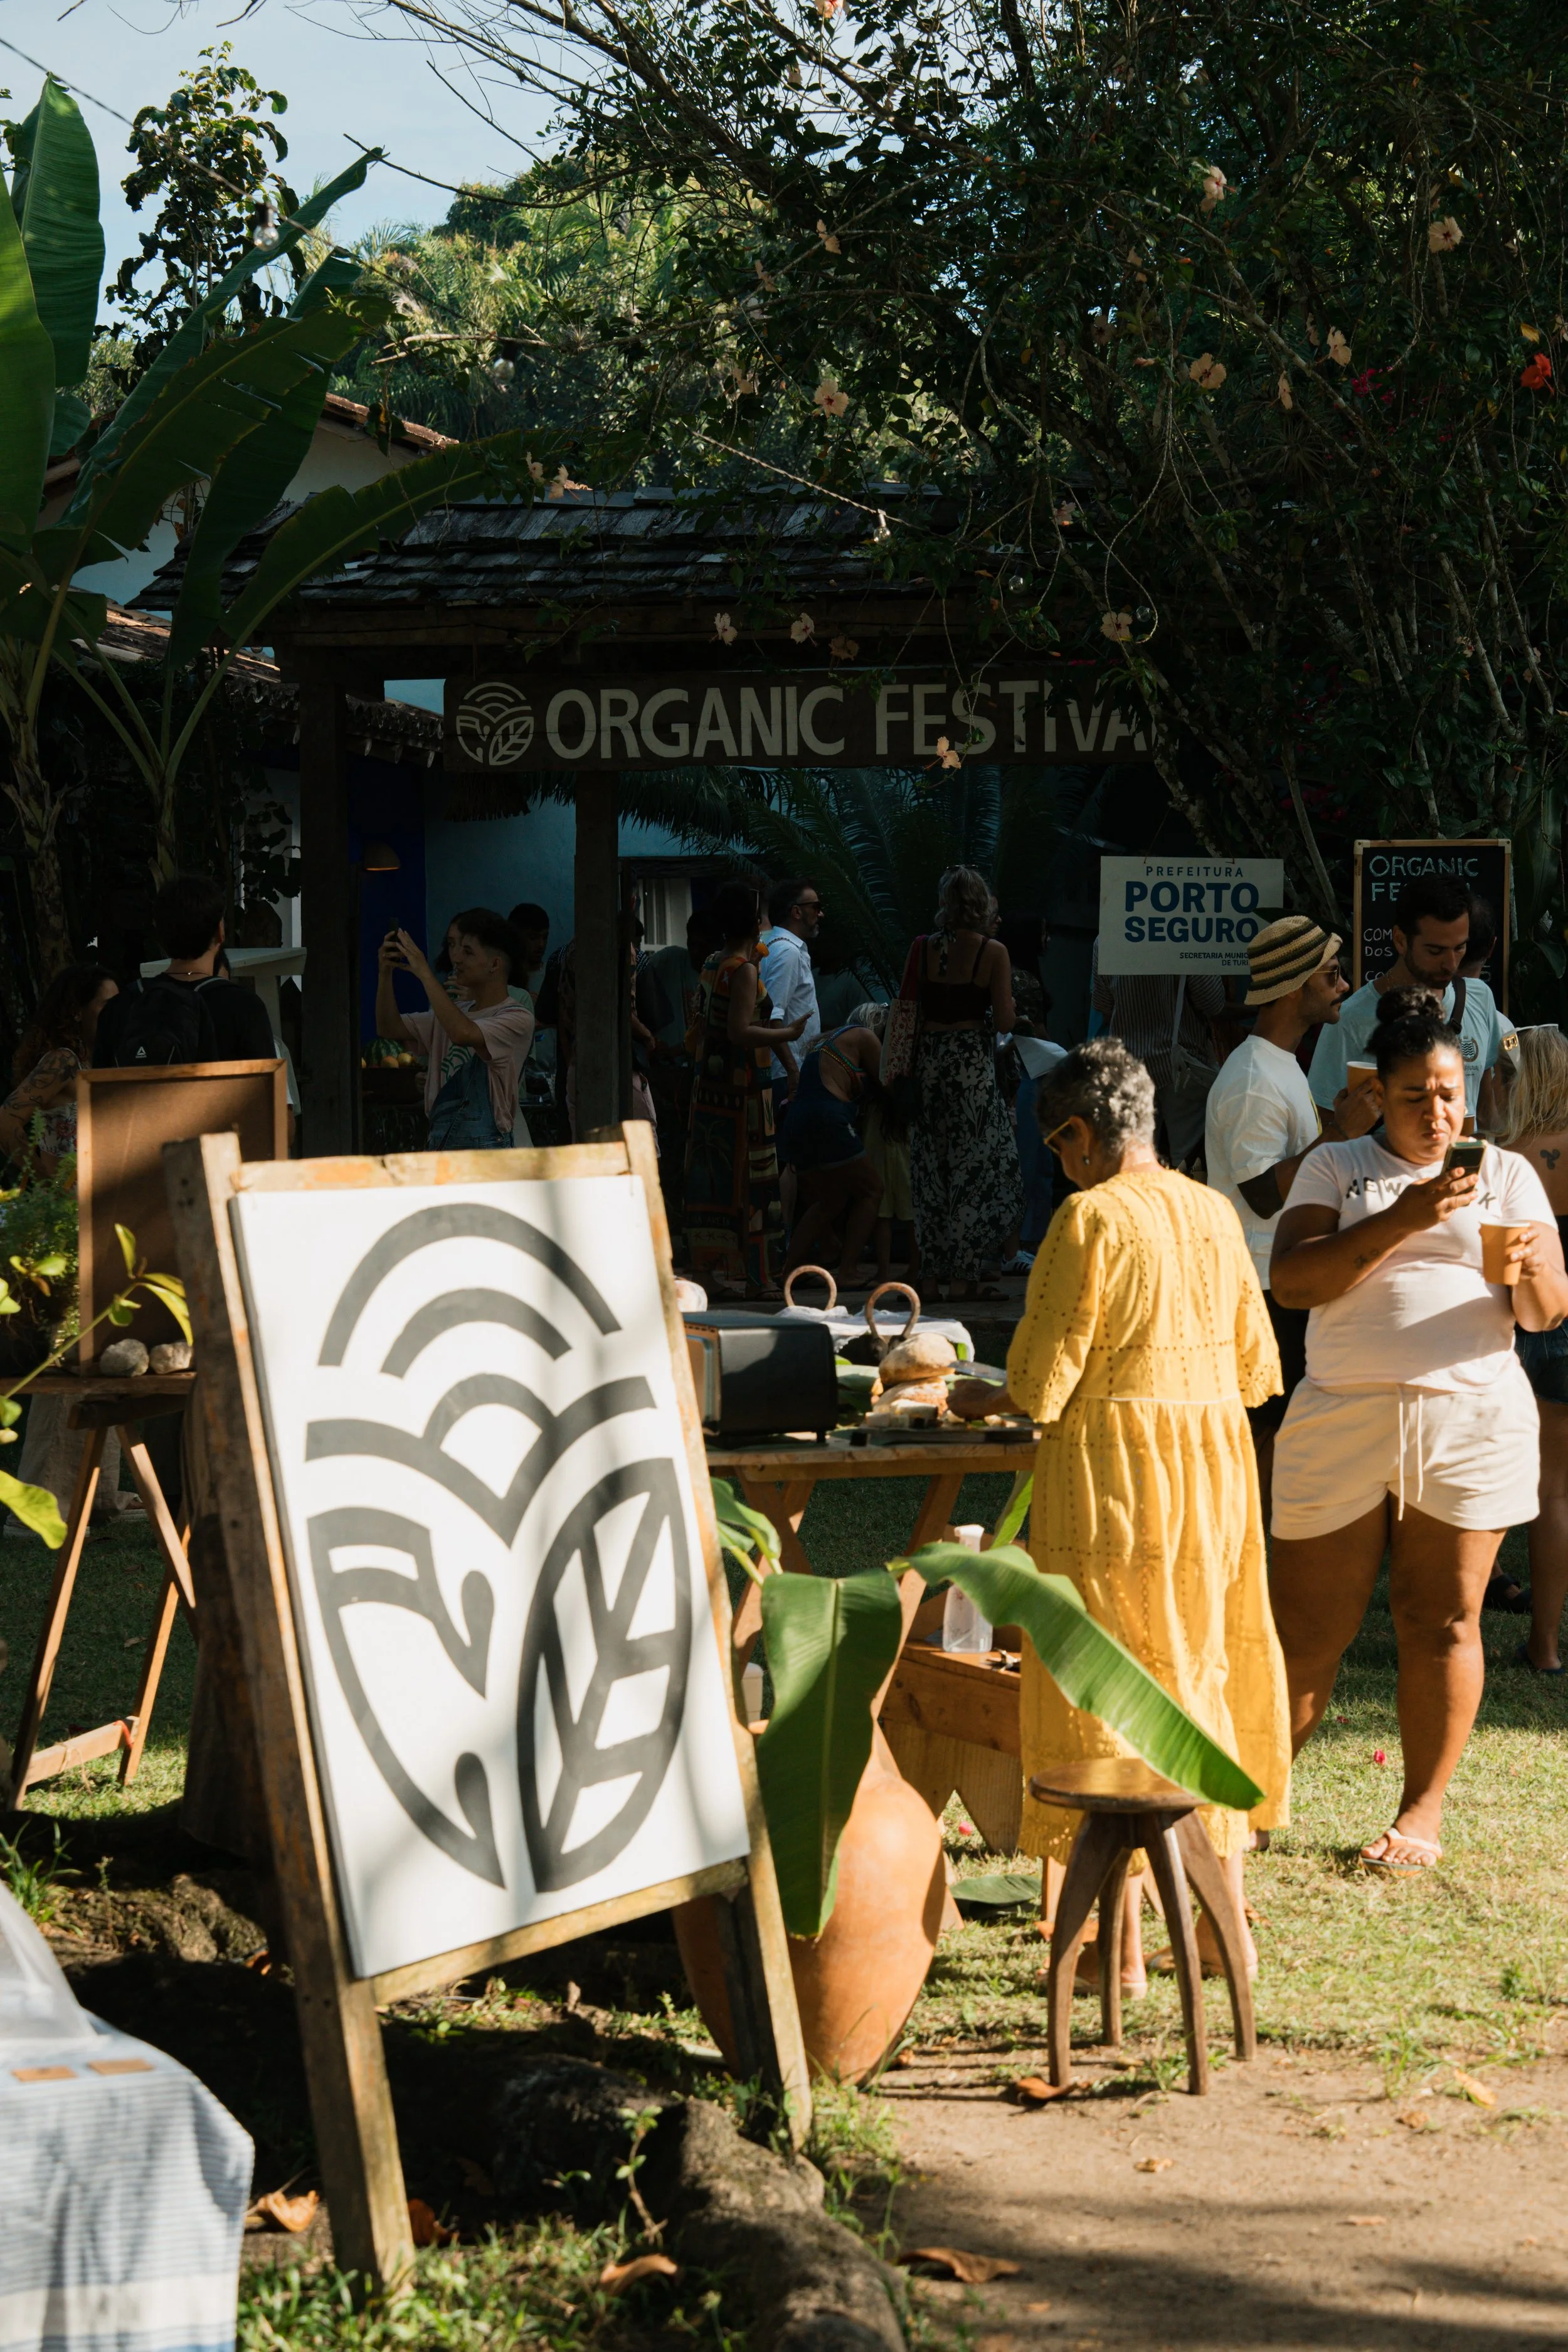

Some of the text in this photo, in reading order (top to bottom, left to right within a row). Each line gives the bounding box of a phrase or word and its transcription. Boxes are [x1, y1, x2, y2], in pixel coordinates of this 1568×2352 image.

[545, 679, 1158, 760] ORGANIC FESTIVA
[1146, 866, 1244, 877] PREFEITURA
[1369, 854, 1479, 877] ORGANIC
[1125, 881, 1259, 914] PORTO
[1124, 916, 1259, 943] SEGURO
